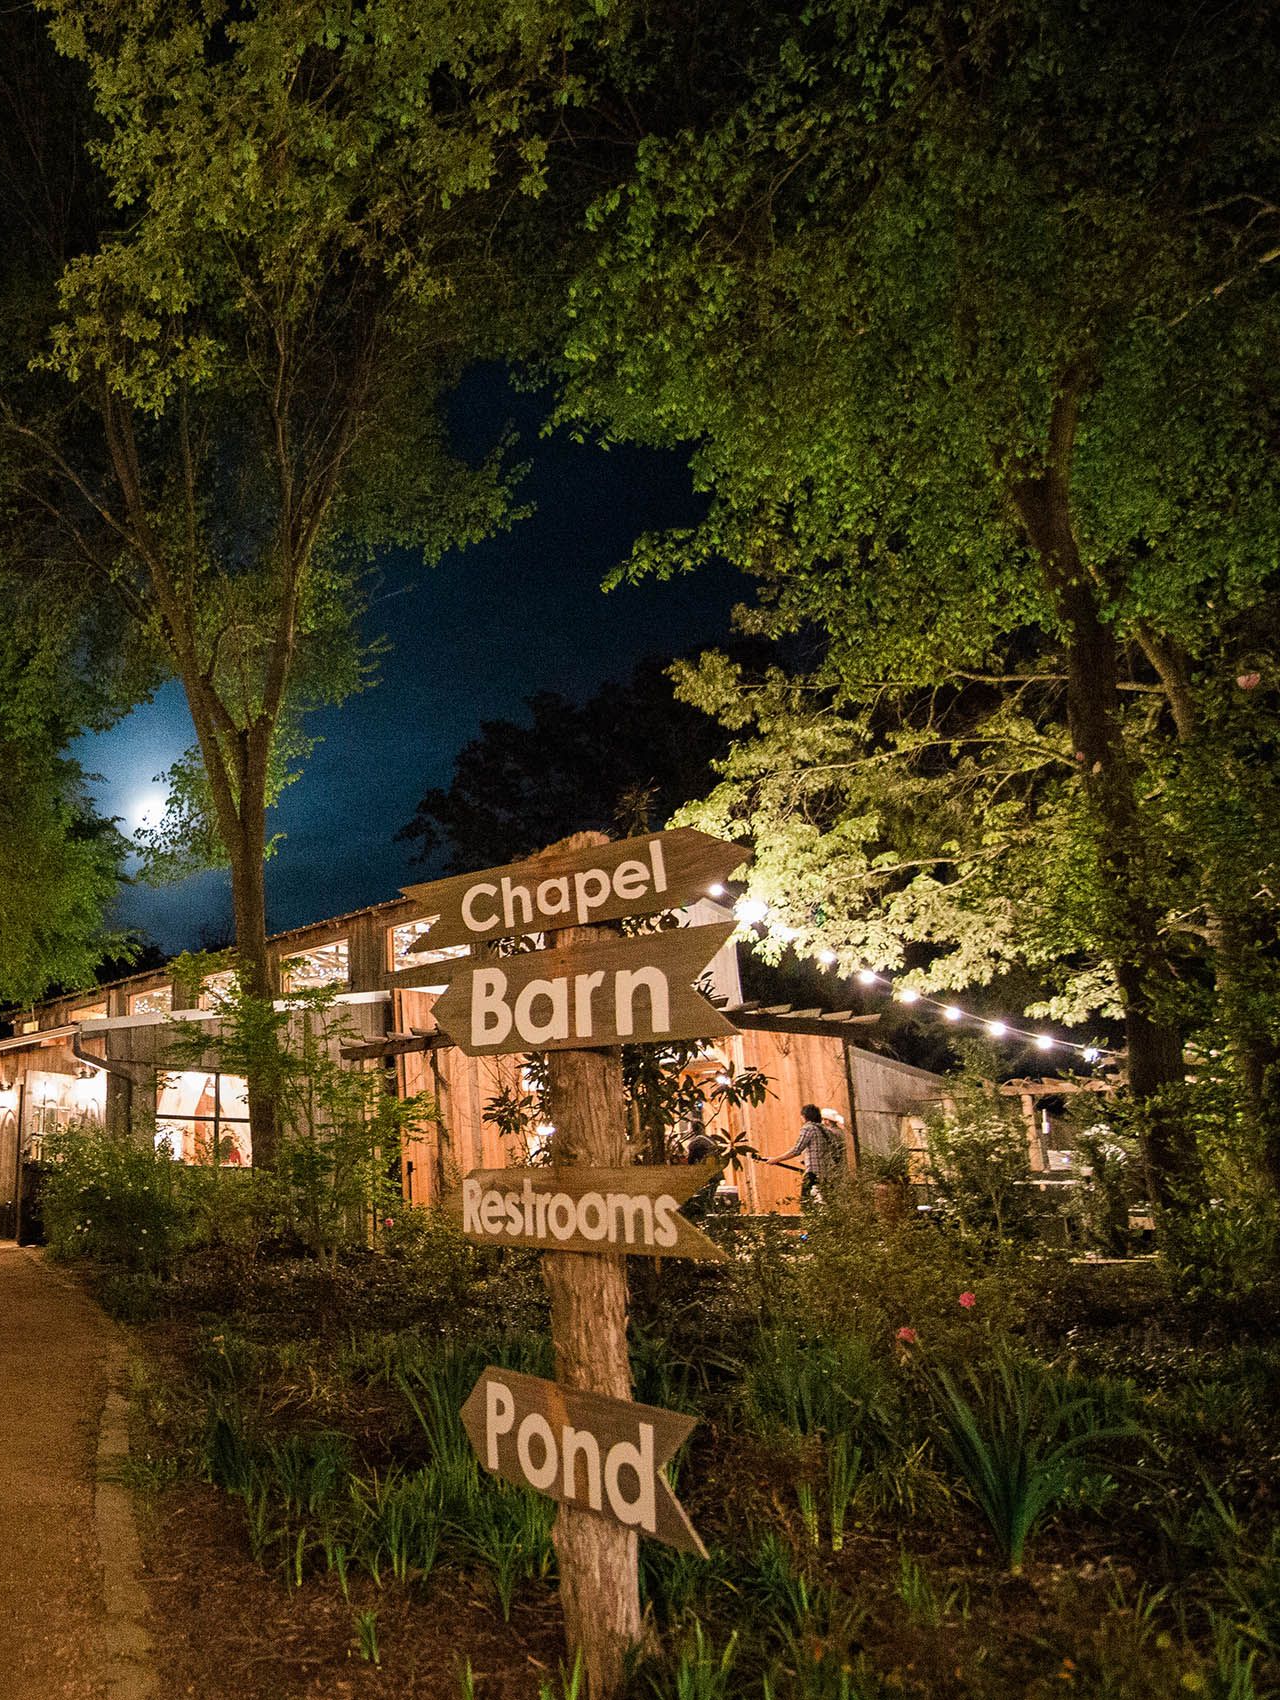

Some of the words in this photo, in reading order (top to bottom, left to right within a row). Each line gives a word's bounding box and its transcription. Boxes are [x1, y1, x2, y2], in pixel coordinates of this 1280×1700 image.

[461, 839, 668, 933] Chapel
[470, 966, 671, 1047] Barn
[462, 1178, 680, 1249] Restrooms
[485, 1380, 657, 1533] Pond
